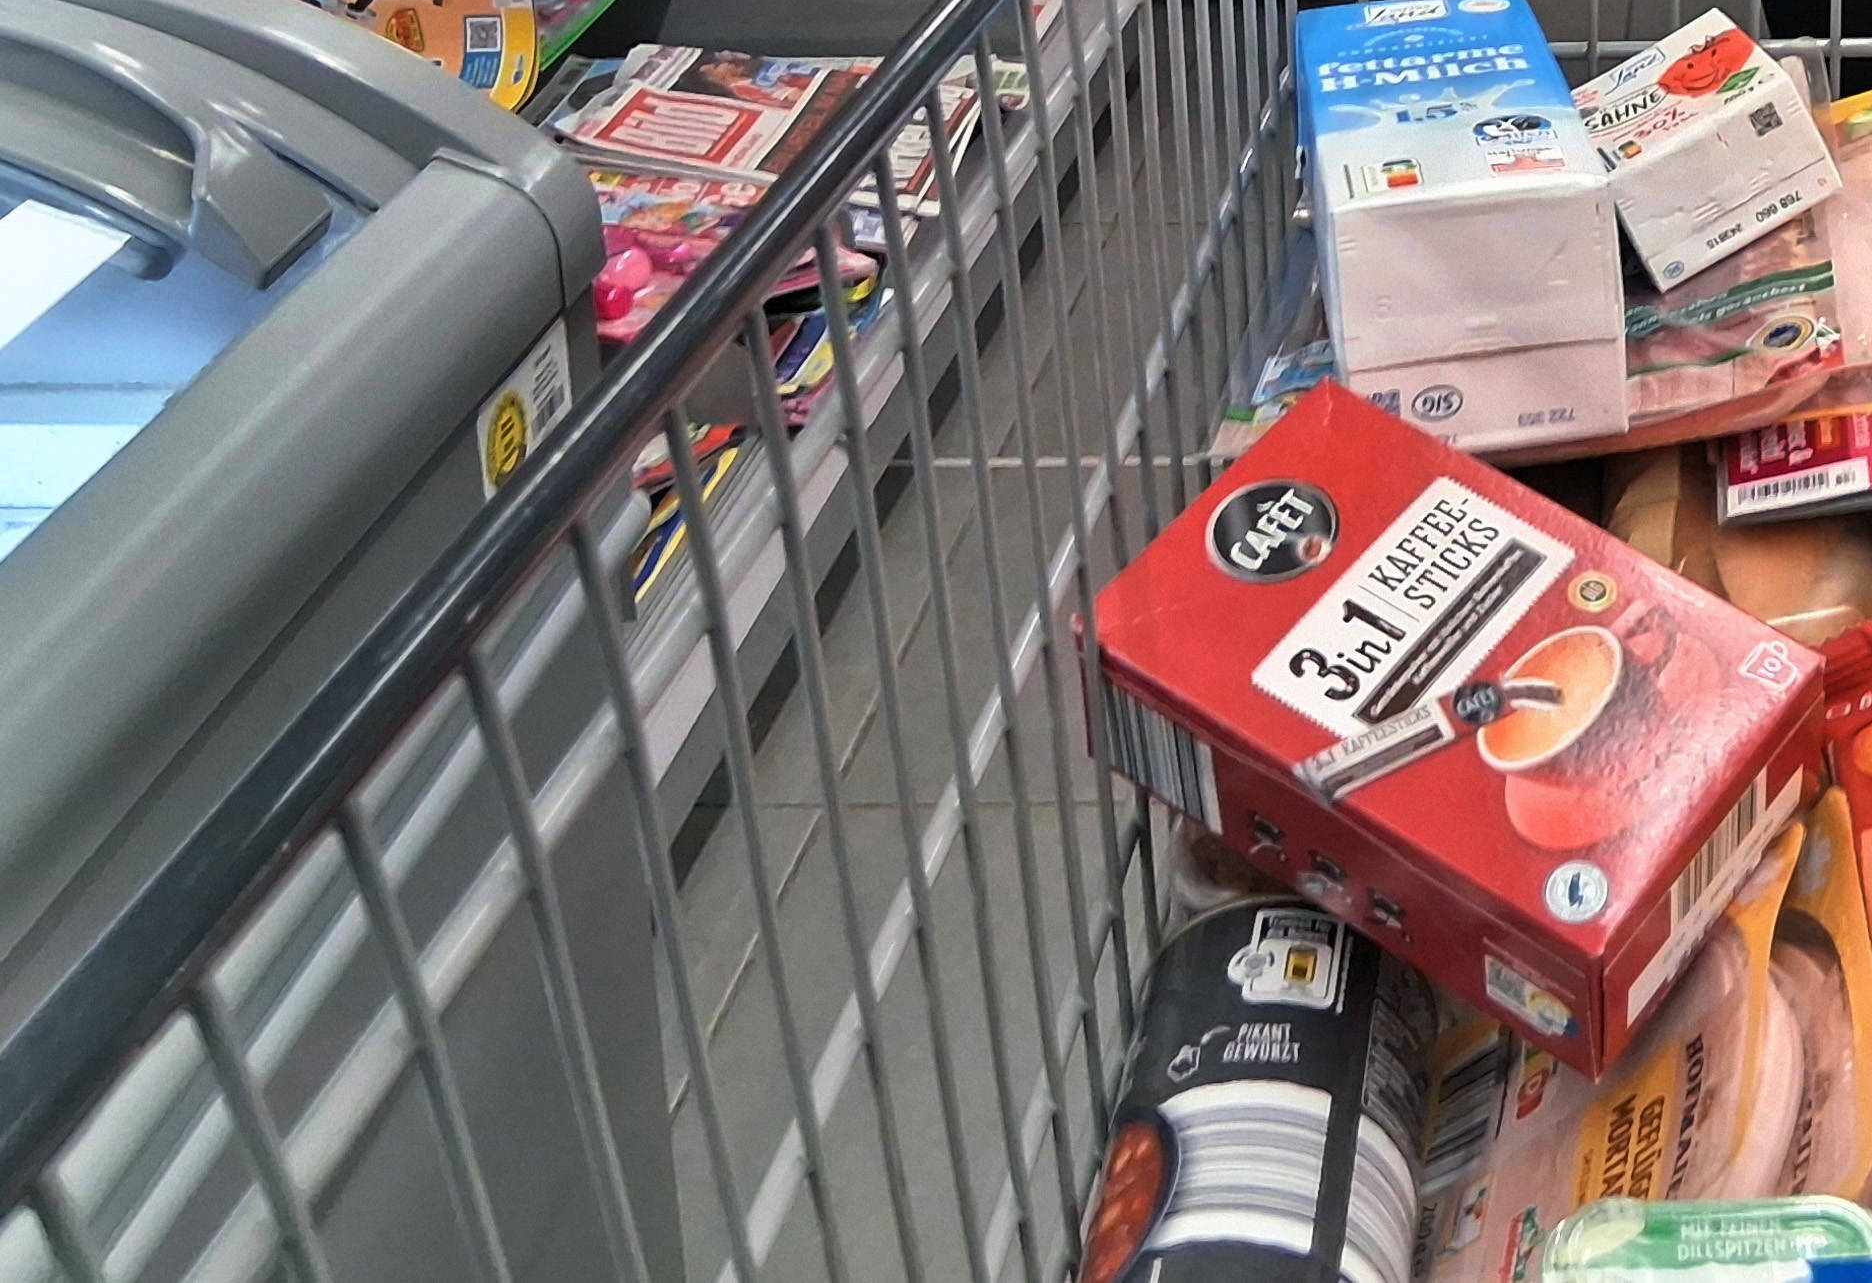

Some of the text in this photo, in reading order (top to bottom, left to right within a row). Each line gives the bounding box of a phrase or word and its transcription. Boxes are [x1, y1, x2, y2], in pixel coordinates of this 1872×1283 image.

[1319, 43, 1524, 76] fettarme
[1320, 55, 1530, 92] H-Milch
[1584, 88, 1662, 131] SAHNE
[1368, 496, 1471, 593] KAFFEE-
[1403, 517, 1502, 609] STICKS
[1761, 659, 1785, 680] 10
[1237, 1023, 1294, 1045] PIKANT
